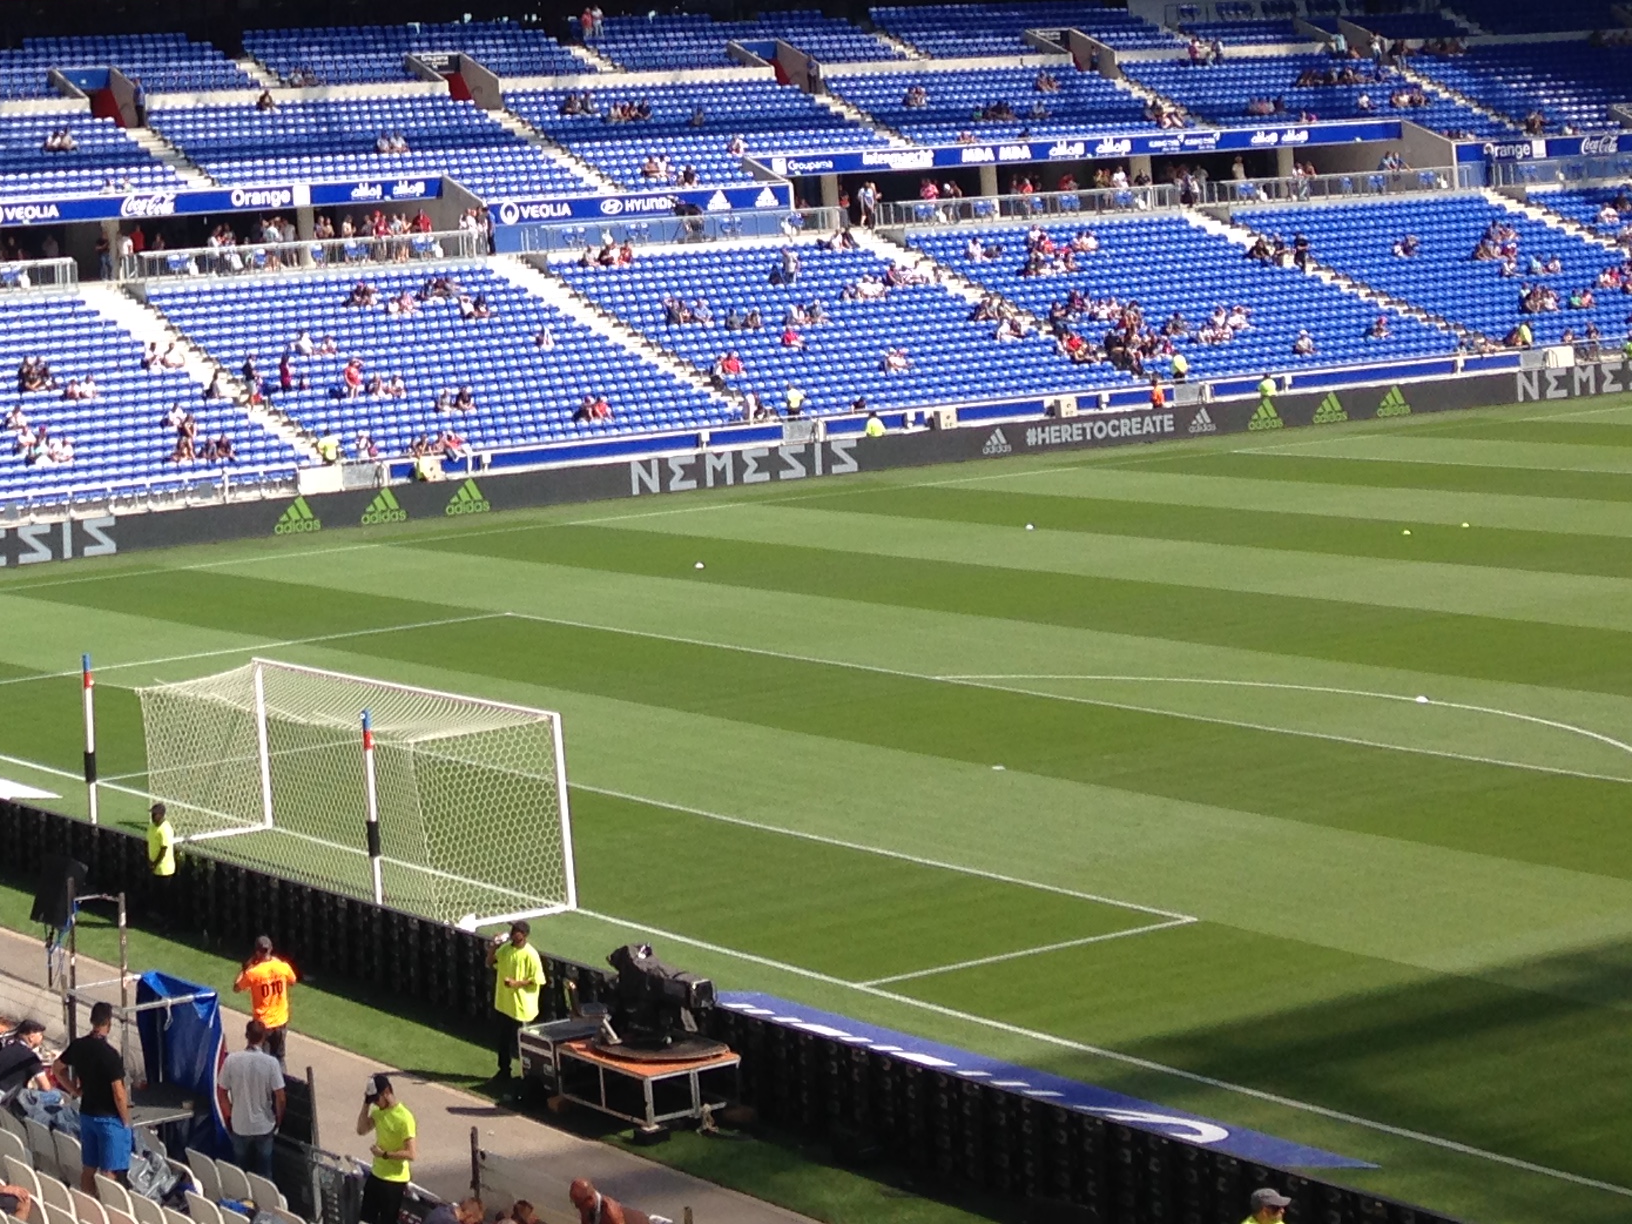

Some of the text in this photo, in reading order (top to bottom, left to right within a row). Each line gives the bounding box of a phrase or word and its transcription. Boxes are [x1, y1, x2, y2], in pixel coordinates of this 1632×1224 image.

[231, 184, 290, 207] Orange
[4, 204, 59, 220] VEOLIA
[519, 202, 572, 219] VEOLIA
[1517, 360, 1632, 402] NEME
[1026, 414, 1175, 446] #HERETOCREATE
[446, 498, 490, 516] adidas
[361, 508, 406, 525] adidas
[274, 518, 321, 534] adidas
